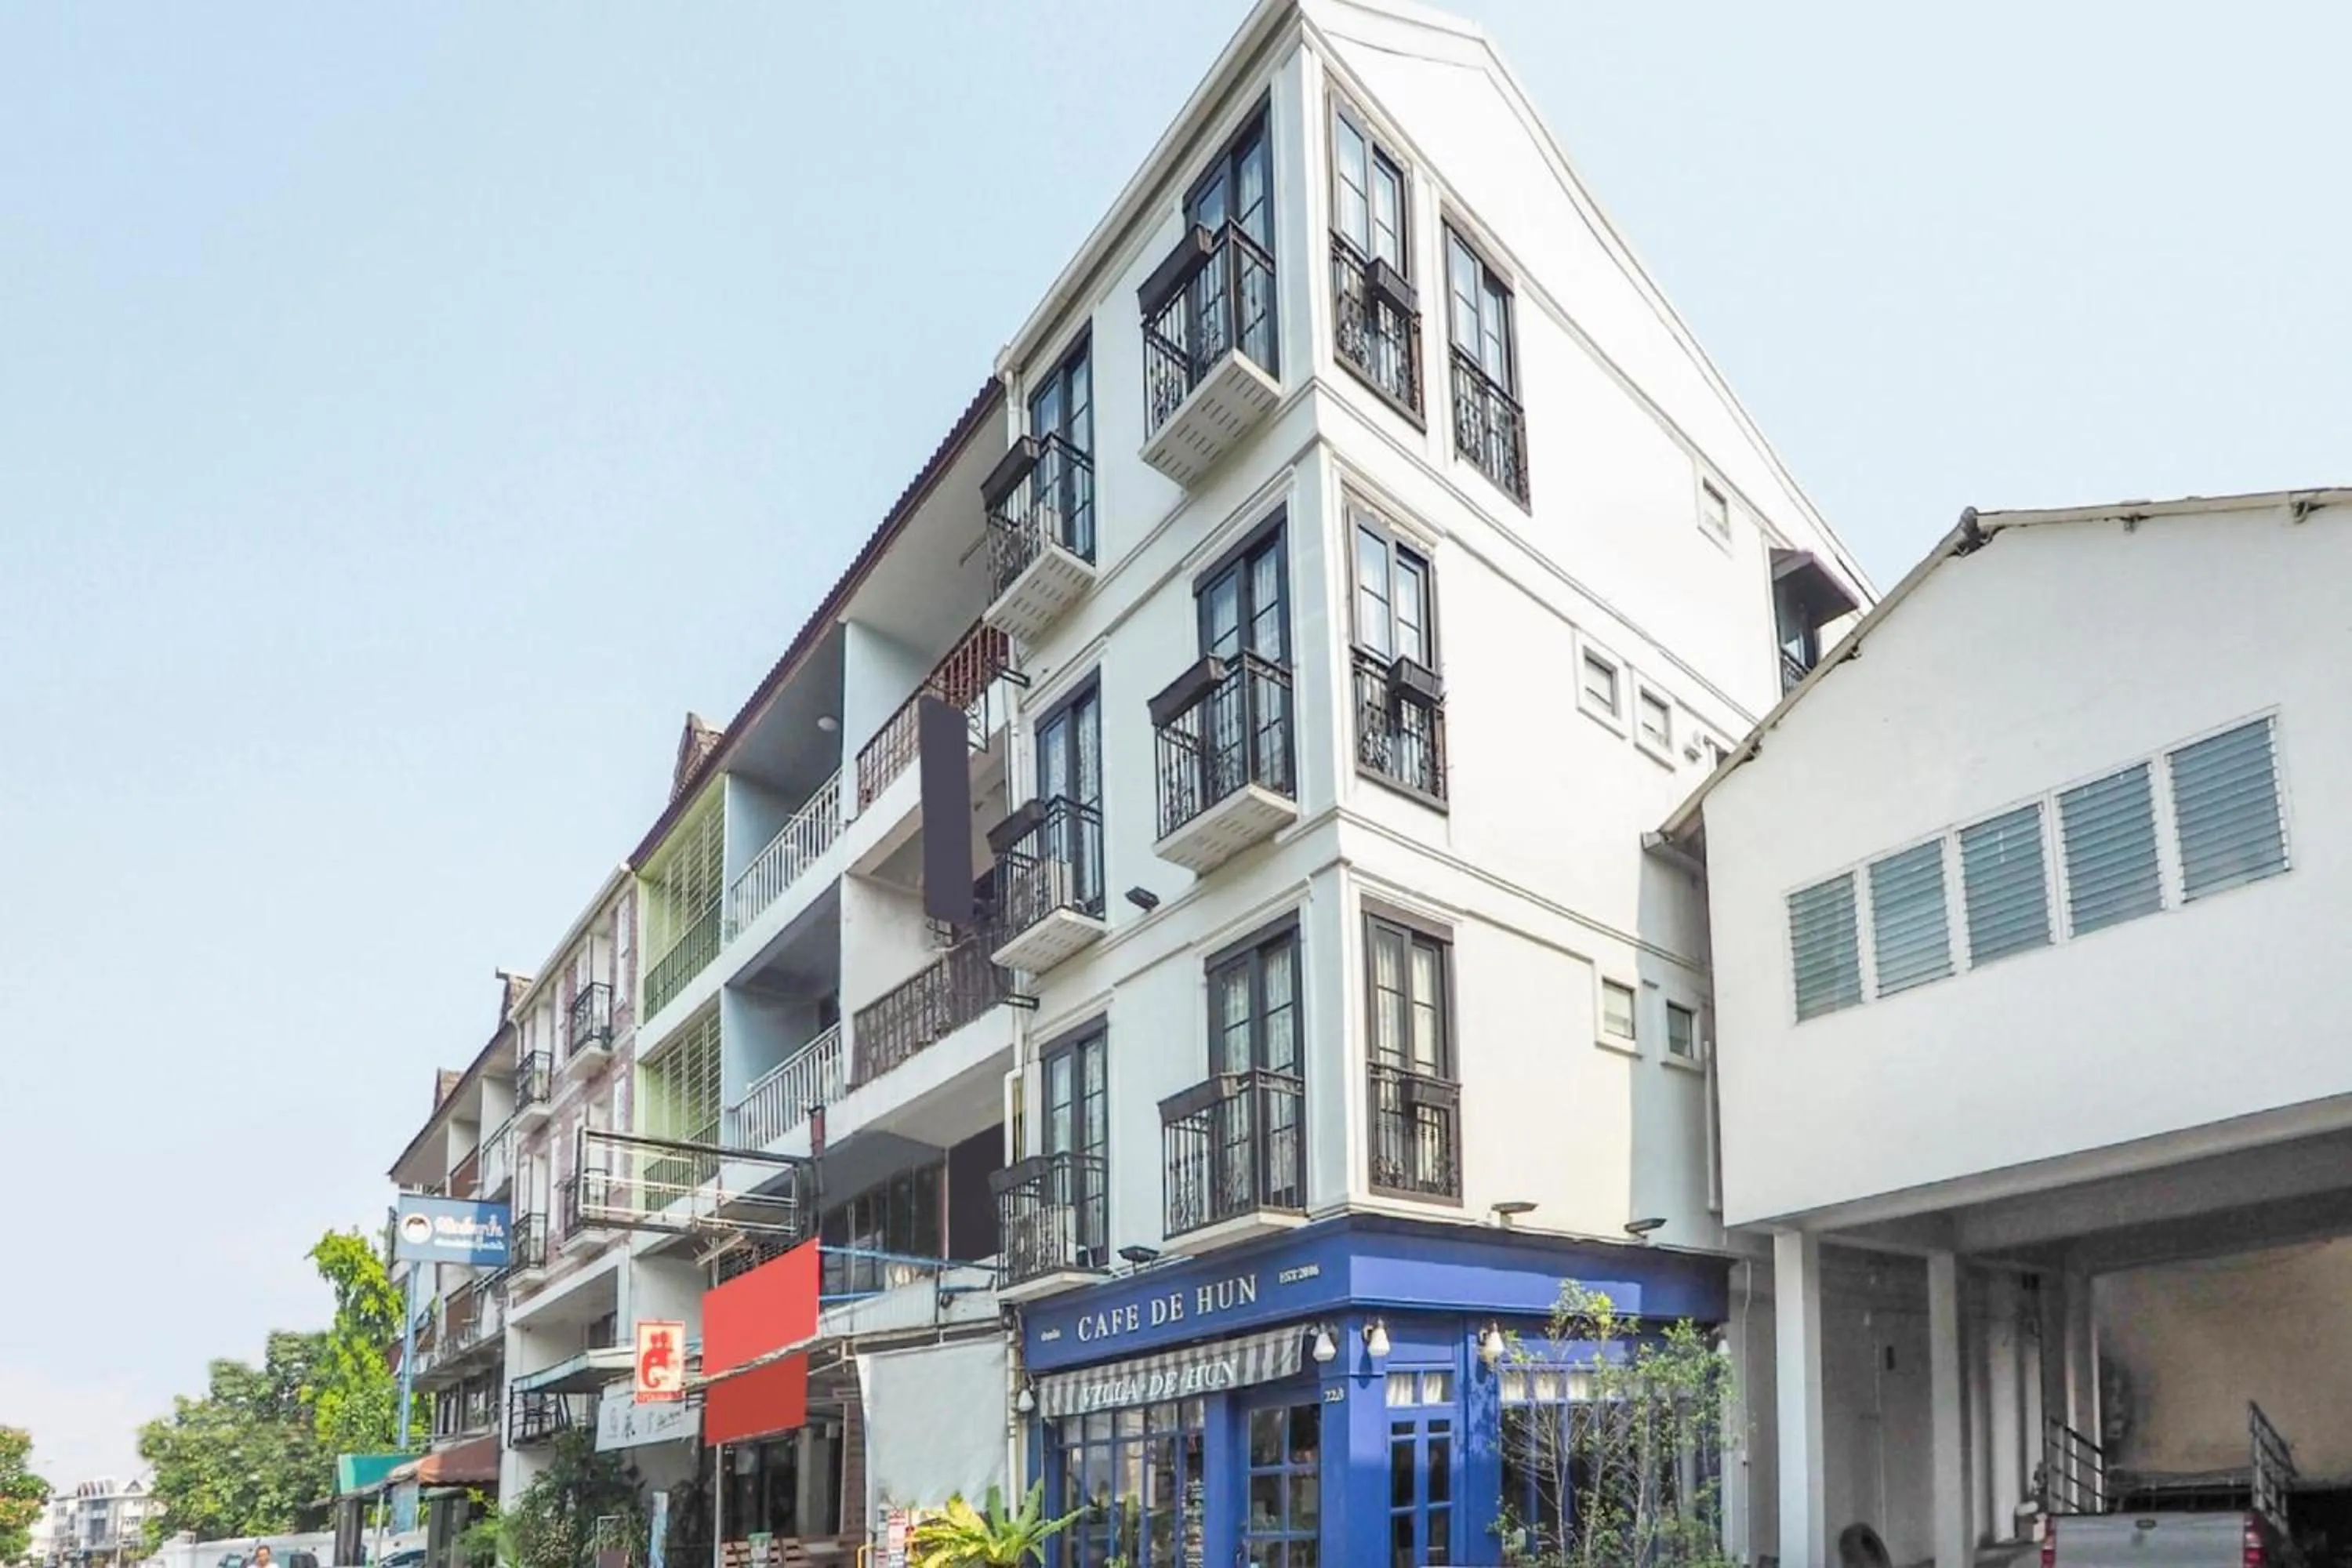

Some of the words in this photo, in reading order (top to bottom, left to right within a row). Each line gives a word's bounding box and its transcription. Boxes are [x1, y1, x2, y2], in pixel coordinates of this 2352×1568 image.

[1077, 1304, 1139, 1342] CAFE
[1150, 1293, 1185, 1327] DE
[1196, 1273, 1257, 1316] HUN
[1081, 1379, 1138, 1408] VILLA
[1149, 1371, 1178, 1399] DE
[1185, 1357, 1239, 1390] HUN
